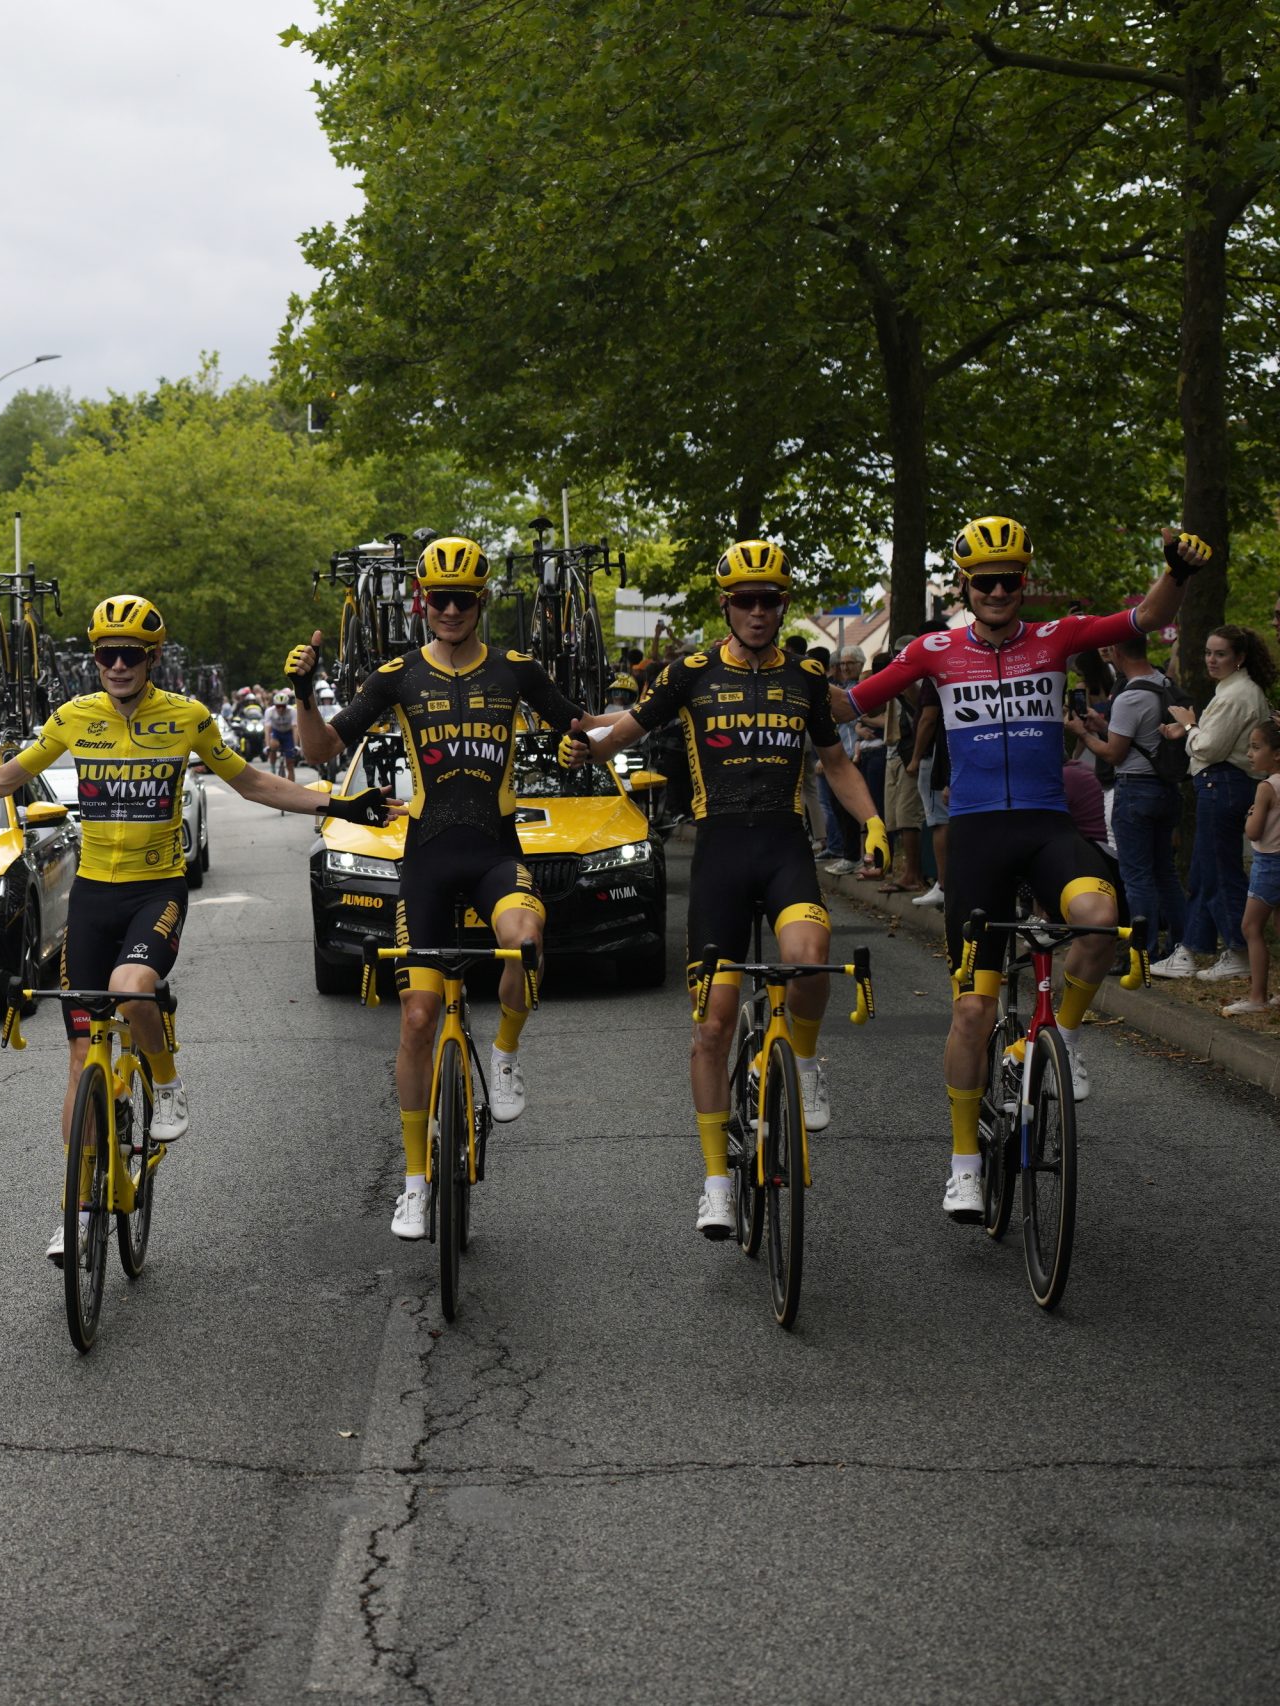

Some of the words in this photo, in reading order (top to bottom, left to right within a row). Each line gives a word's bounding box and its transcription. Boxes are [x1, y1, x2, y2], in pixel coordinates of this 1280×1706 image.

[964, 645, 990, 655] JUMBO
[1005, 663, 1031, 672] lease
[953, 678, 1053, 704] JUMBO
[985, 700, 1054, 720] VISMA
[133, 721, 184, 736] LCL
[704, 713, 806, 733] JUMBO
[420, 722, 509, 748] JUMBO
[739, 731, 801, 749] VISMA
[973, 727, 1044, 742] cervélo
[75, 739, 117, 750] Santini
[447, 741, 504, 768] VISMA
[722, 756, 788, 767] cervélo
[79, 763, 174, 781] JUMBO
[436, 768, 492, 784] cervélo
[106, 781, 170, 798] VISMA
[341, 893, 383, 909] JUMBO
[608, 887, 638, 902] VISMA
[360, 963, 371, 999] SRAM
[0, 1006, 15, 1039] SRAM
[162, 1010, 177, 1045] SRAM
